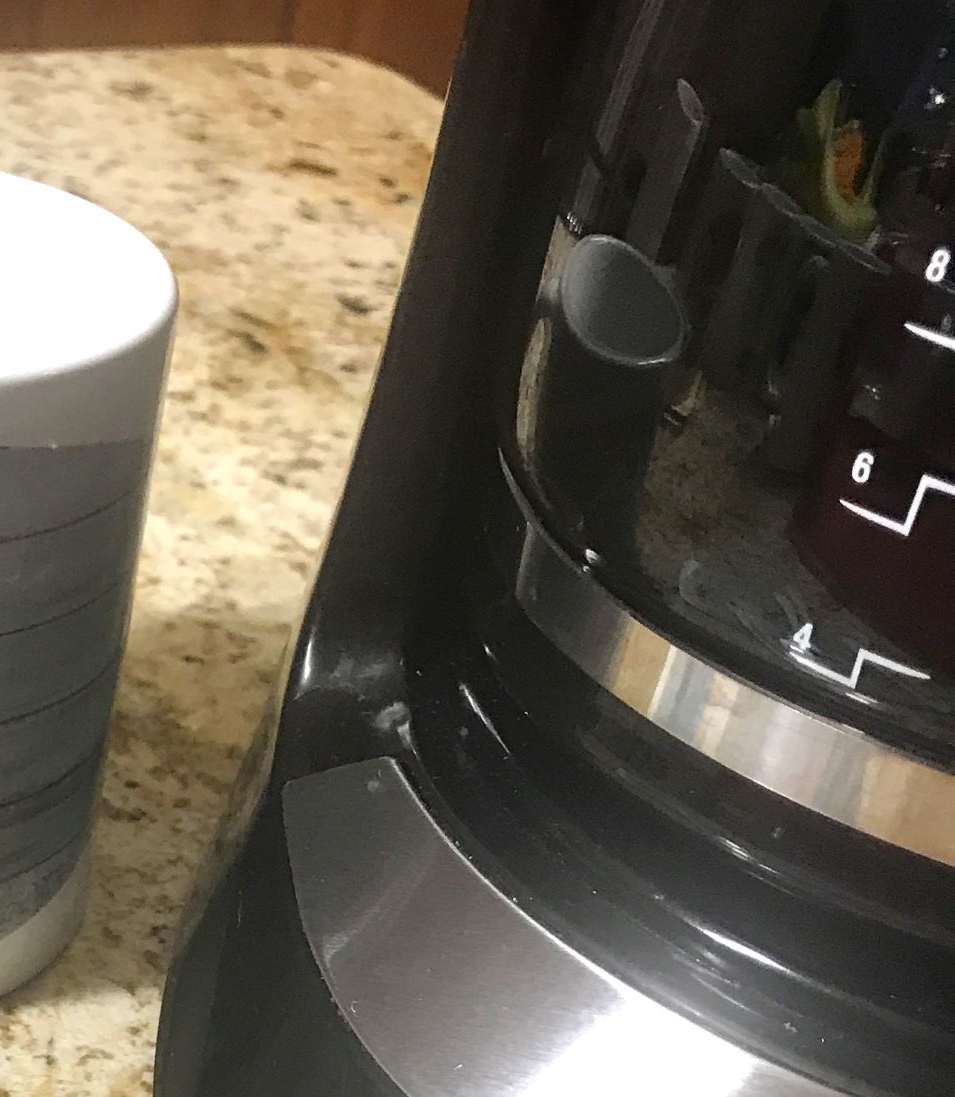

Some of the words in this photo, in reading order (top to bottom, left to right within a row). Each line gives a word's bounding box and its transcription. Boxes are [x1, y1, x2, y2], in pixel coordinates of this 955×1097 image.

[925, 249, 951, 283] 8
[851, 452, 874, 484] 6
[792, 622, 814, 651] 4
